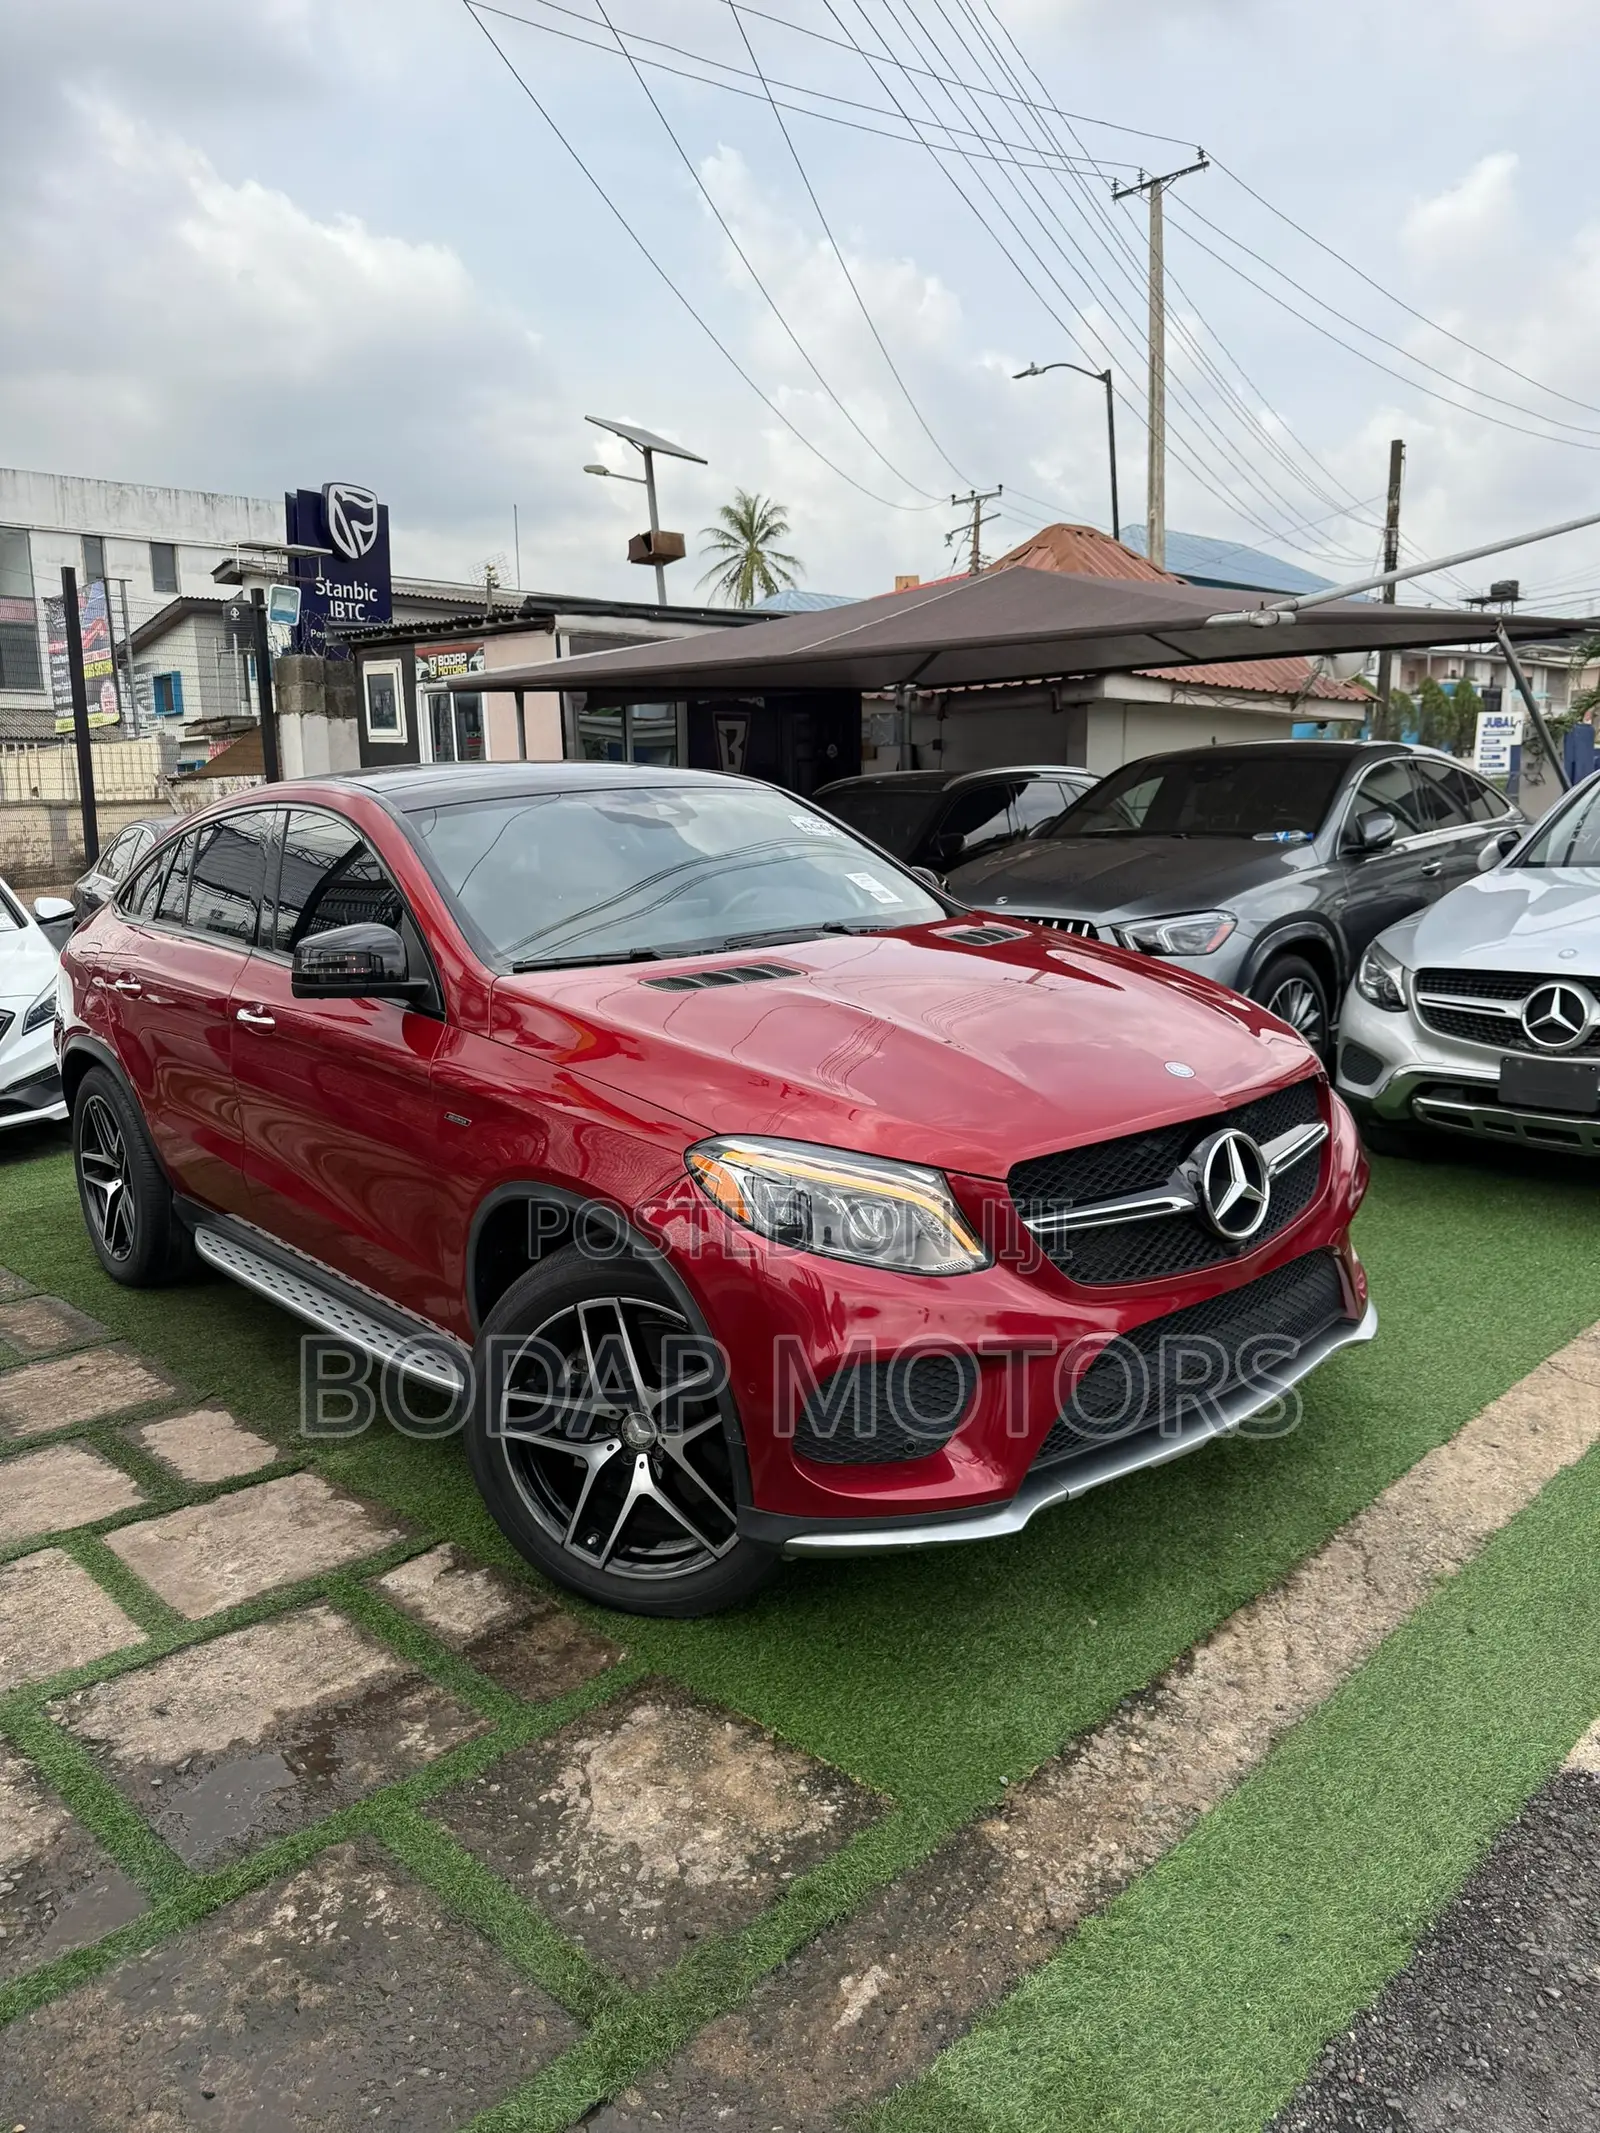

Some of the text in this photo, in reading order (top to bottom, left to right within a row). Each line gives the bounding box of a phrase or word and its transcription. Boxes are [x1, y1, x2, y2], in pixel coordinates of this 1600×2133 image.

[315, 577, 379, 602] Stanbic
[329, 600, 366, 621] IBTC
[310, 628, 327, 640] Per
[437, 663, 468, 676] MOTORS
